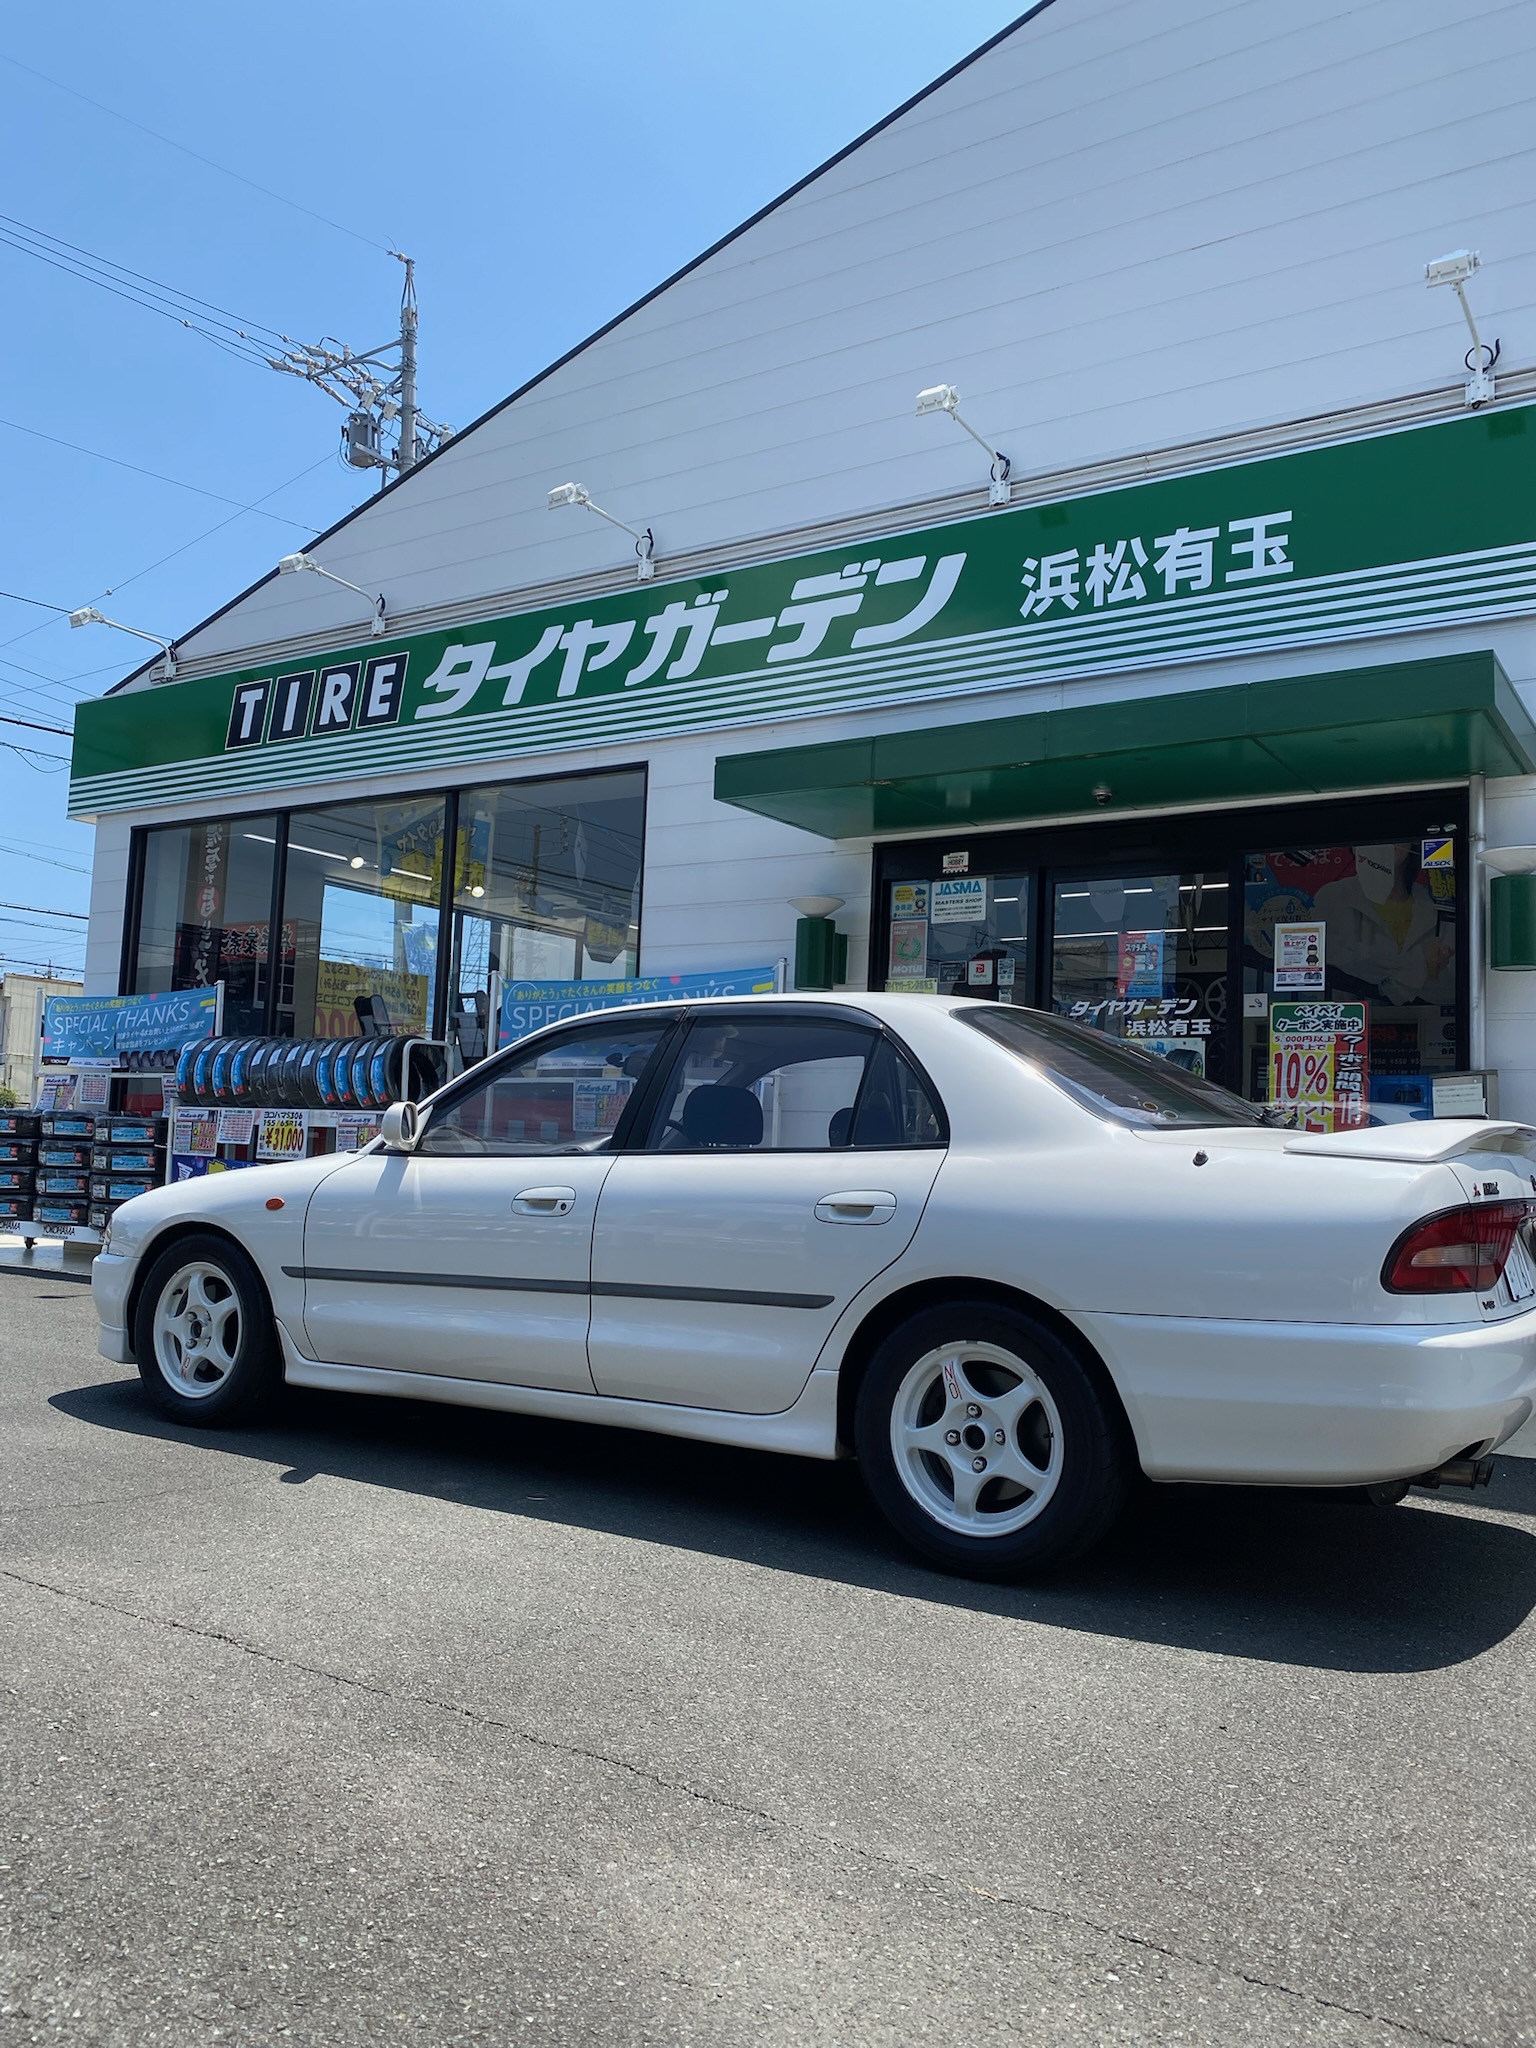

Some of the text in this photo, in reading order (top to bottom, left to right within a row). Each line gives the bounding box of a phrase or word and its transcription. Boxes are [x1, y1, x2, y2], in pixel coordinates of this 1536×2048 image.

[238, 510, 1294, 740] TIRE タイヤガーデン 浜松有玉
[935, 880, 982, 896] JASMA
[892, 965, 924, 974] MOTUL
[1069, 998, 1198, 1017] タイヤガーデン
[1295, 1005, 1343, 1017] ペイペイ
[53, 1000, 190, 1036] SPECIAL THANKS
[1276, 1019, 1361, 1031] クーポン実施中
[1126, 1018, 1212, 1037] 浜松有玉
[1274, 1052, 1329, 1100] 10%
[263, 1111, 303, 1120] ヨコハマS306
[265, 1127, 304, 1152] ¥31,000
[42, 1224, 76, 1235] YOKOHAMA
